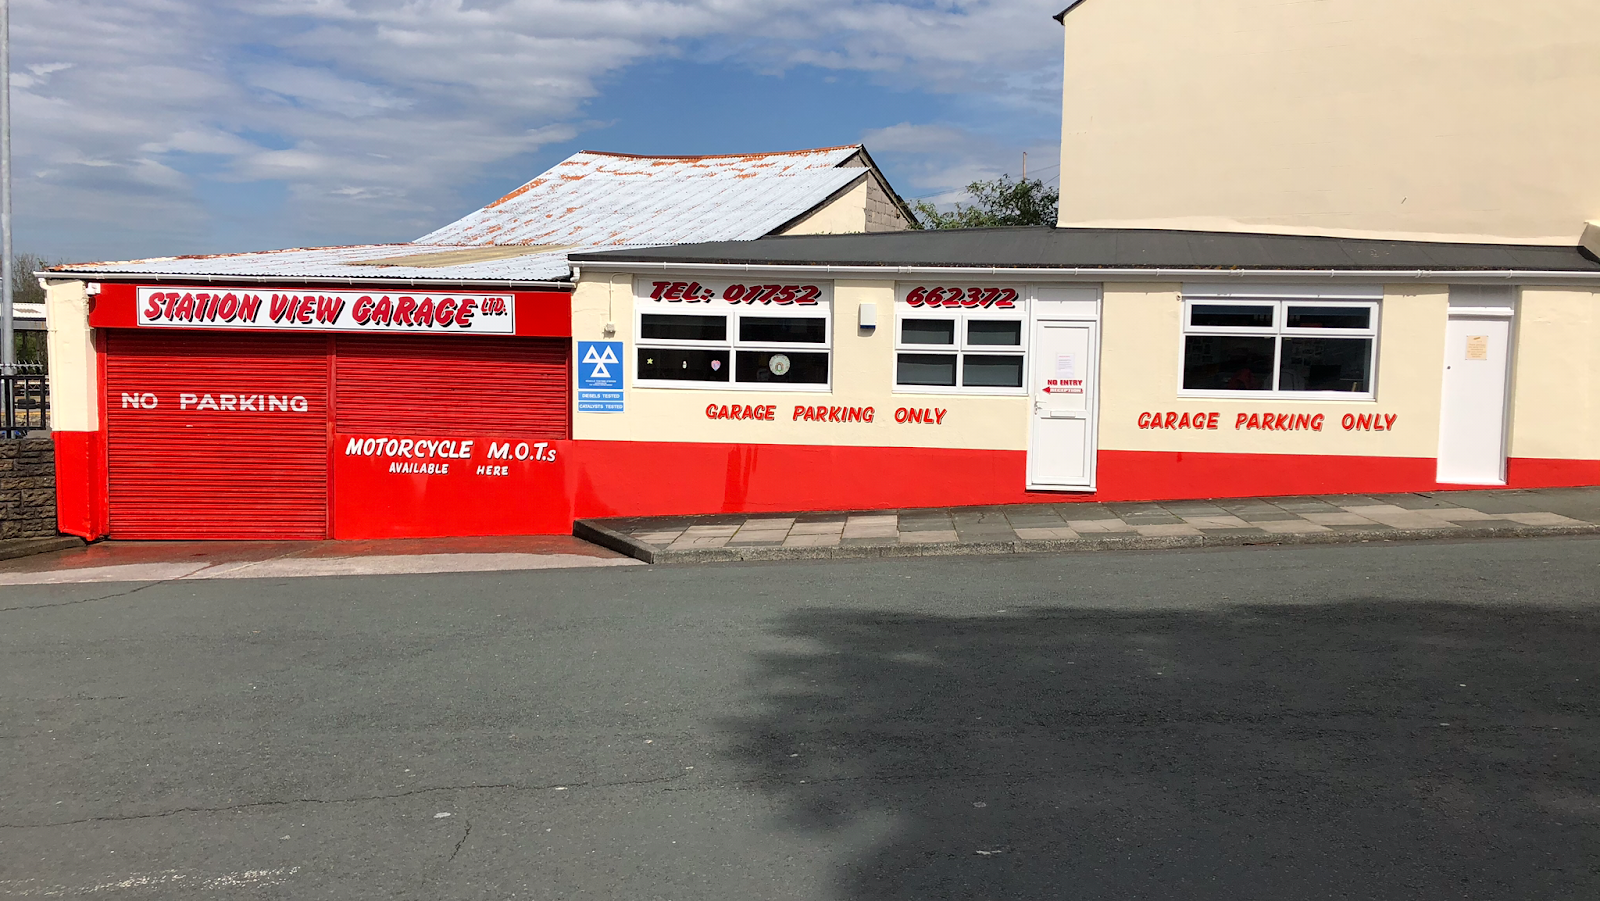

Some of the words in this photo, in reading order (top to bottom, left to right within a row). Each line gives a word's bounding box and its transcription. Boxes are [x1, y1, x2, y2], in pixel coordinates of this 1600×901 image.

[648, 281, 714, 304] TEL:
[722, 283, 822, 306] 01752
[905, 286, 1019, 309] 662372
[143, 291, 261, 323] STATION
[269, 294, 349, 325] VIEW
[351, 295, 477, 328] GARAGE
[121, 392, 158, 409] NO
[180, 393, 308, 412] PARKING
[705, 403, 776, 422] GARAGE
[792, 405, 875, 424] PARKING
[894, 407, 947, 425] ONLY
[1137, 411, 1220, 431] GARAGE
[1234, 412, 1325, 432] PARKING
[1341, 412, 1398, 432] ONLY
[345, 438, 473, 458] MOTORCYCLE
[389, 462, 449, 475] AVAILABLE
[476, 465, 509, 477] HERE
